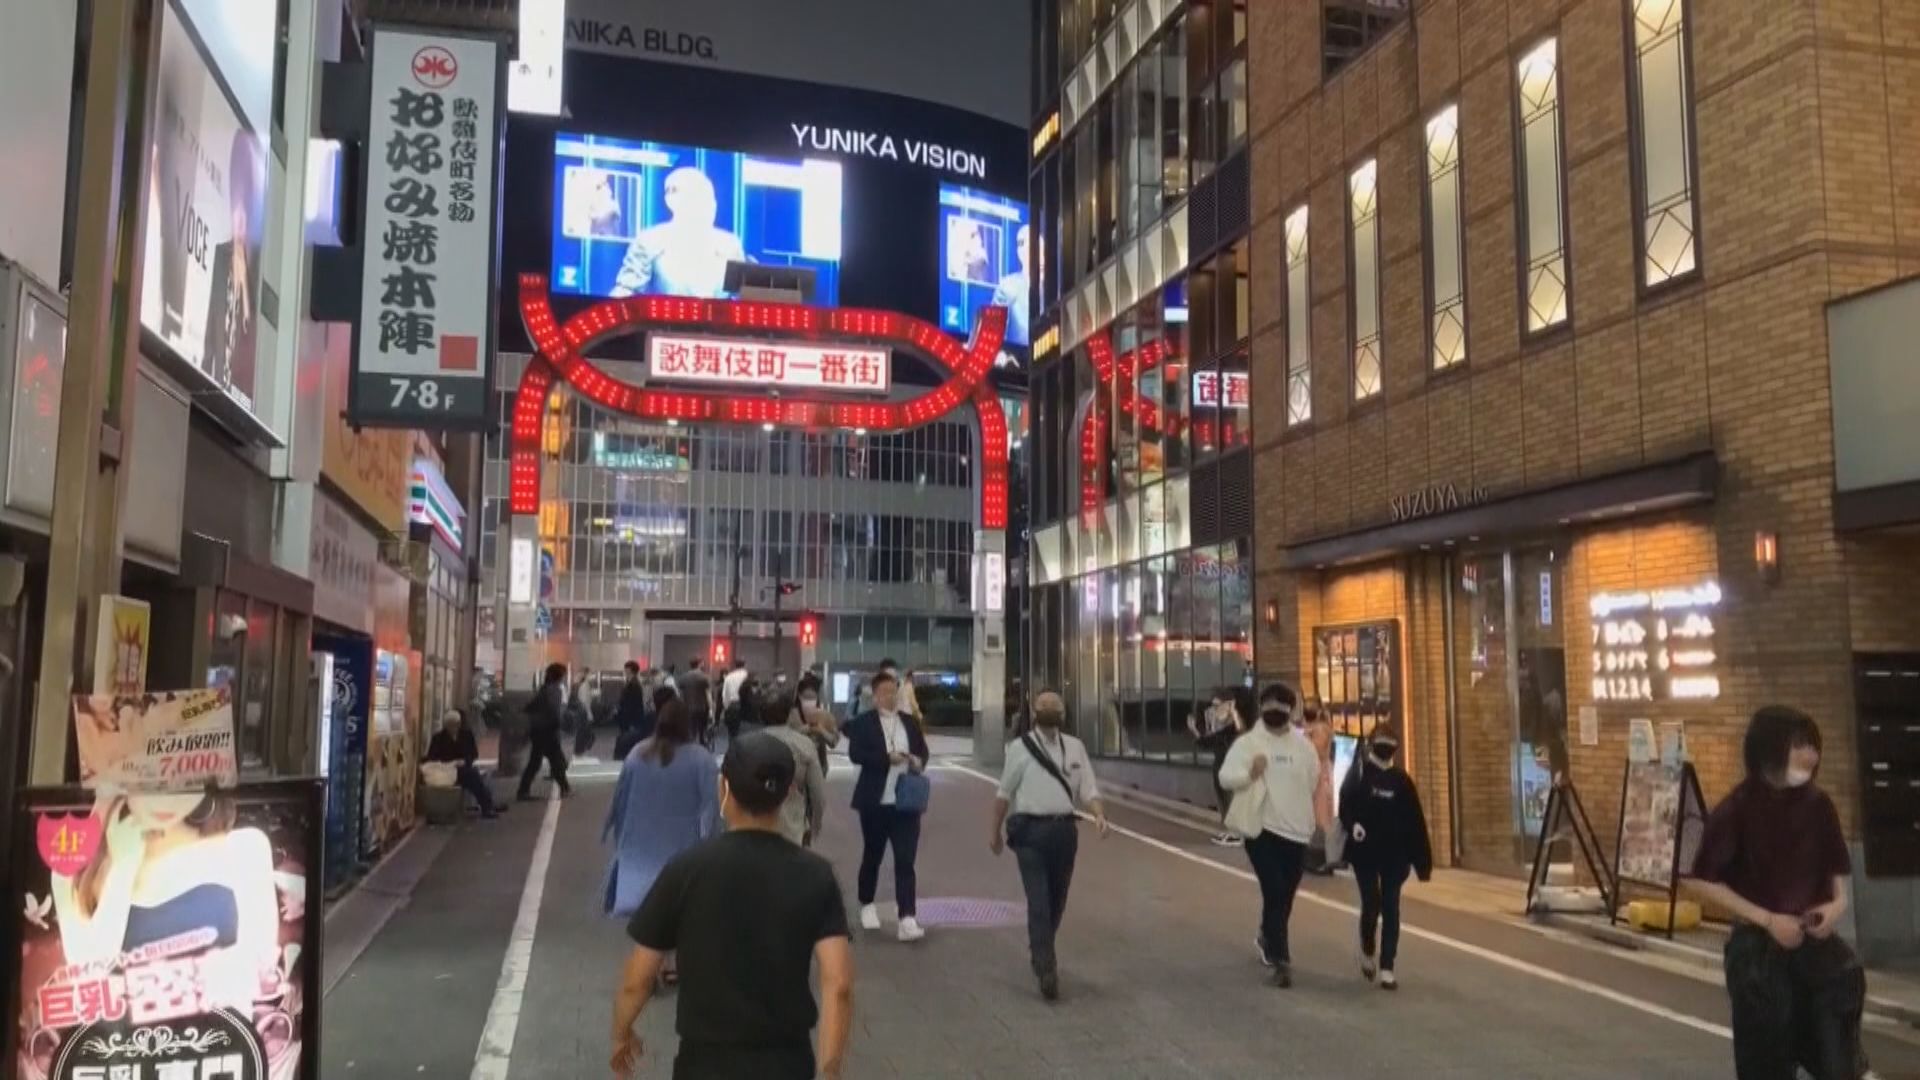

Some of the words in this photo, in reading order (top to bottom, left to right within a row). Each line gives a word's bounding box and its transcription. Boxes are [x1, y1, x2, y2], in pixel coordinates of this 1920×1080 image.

[643, 28, 718, 61] BLDG.
[448, 97, 478, 223] 歌舞伎町名物
[791, 123, 898, 160] YUNIKA
[904, 139, 986, 178] VISION
[174, 176, 210, 271] VOCE
[377, 86, 445, 355] お好み焼本陣
[659, 342, 880, 385] 歌舞伎町一番街
[50, 823, 87, 854] 4F
